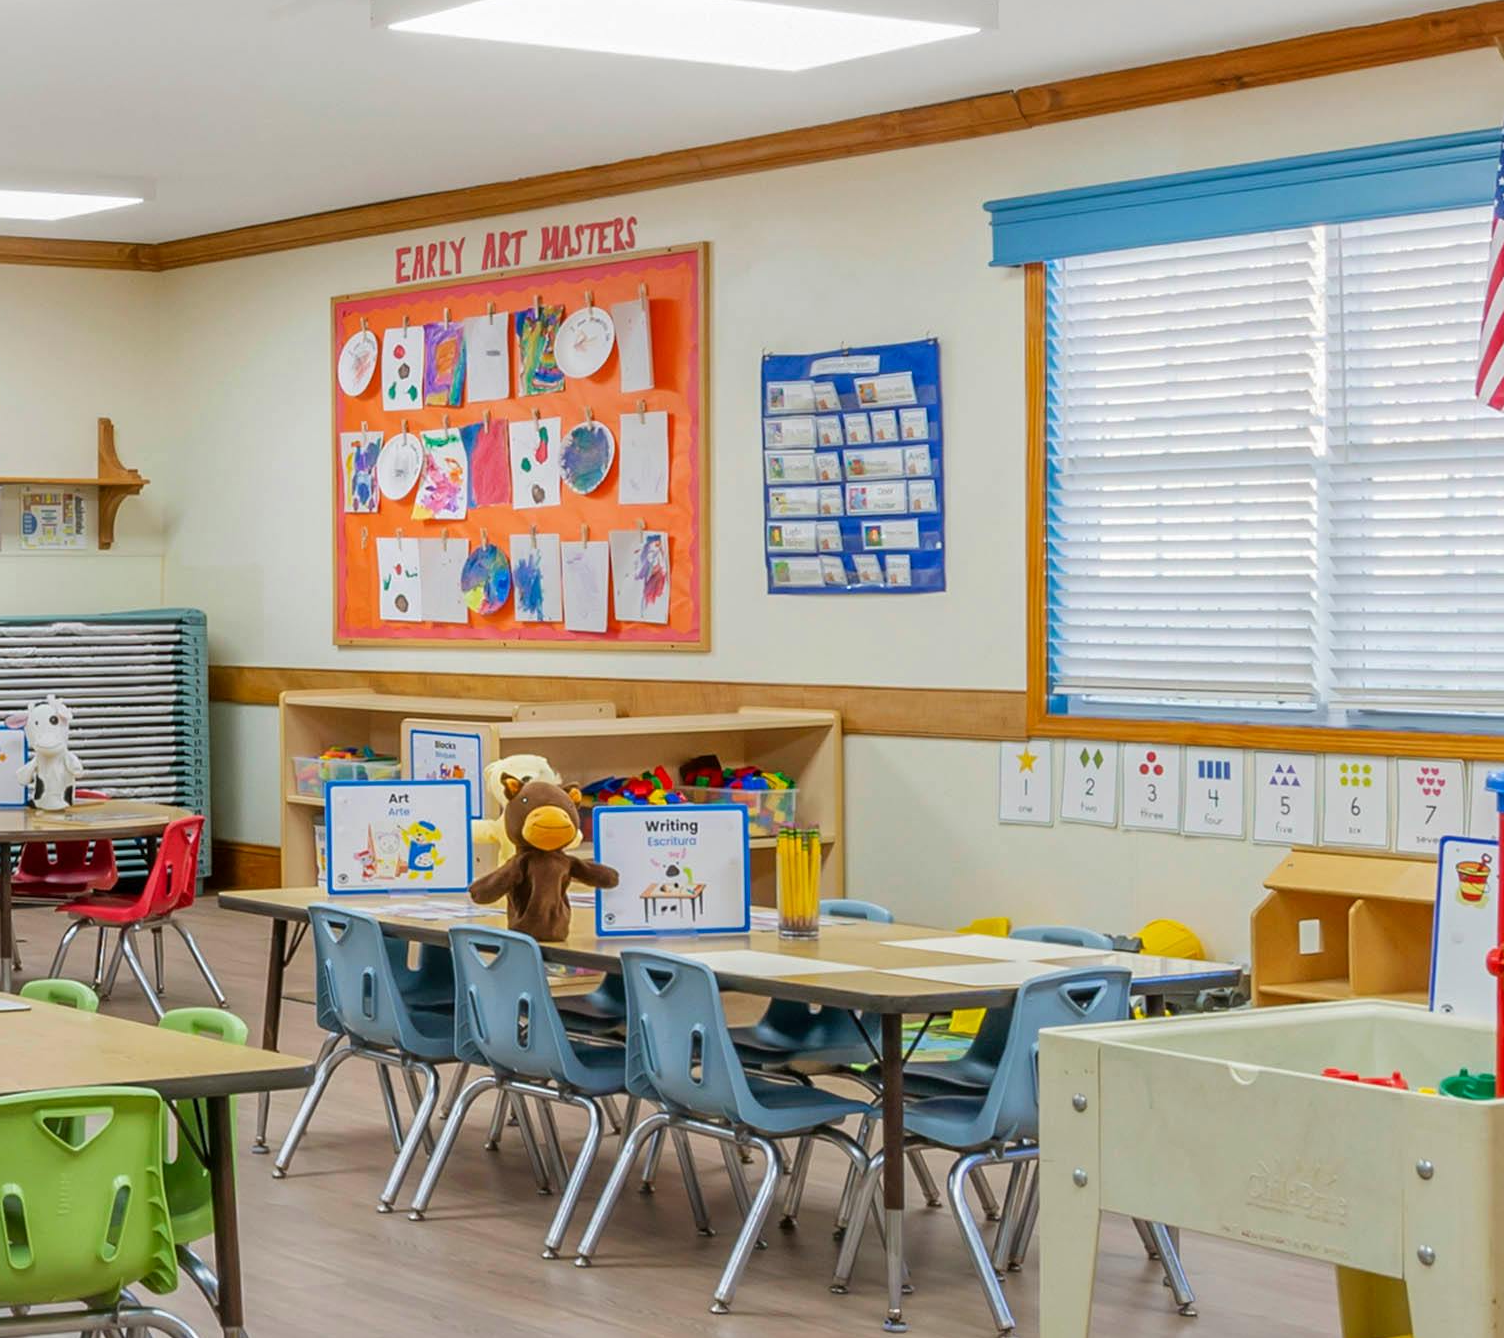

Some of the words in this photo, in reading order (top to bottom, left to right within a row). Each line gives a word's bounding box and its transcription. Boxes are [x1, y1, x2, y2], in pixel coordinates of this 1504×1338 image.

[395, 237, 466, 284] EARLY
[481, 230, 528, 271] ART
[539, 216, 638, 261] MASTERS
[434, 740, 456, 751] Blocks
[1023, 778, 1028, 796] 1
[1085, 778, 1095, 796] 2
[1147, 783, 1157, 802] 3
[388, 793, 409, 804] Art
[1208, 789, 1220, 807] 4
[388, 807, 410, 816] Arte
[1018, 805, 1032, 813] one
[1080, 801, 1097, 813] two
[1280, 796, 1291, 816] 5
[1351, 796, 1361, 816] 6
[1140, 809, 1164, 820] three
[1204, 813, 1223, 826] four
[1425, 805, 1437, 825] 7
[645, 819, 698, 834] Writing
[1275, 821, 1293, 834] five
[1348, 825, 1362, 835] six
[647, 835, 697, 847] Escritura
[1416, 835, 1439, 844] seve
